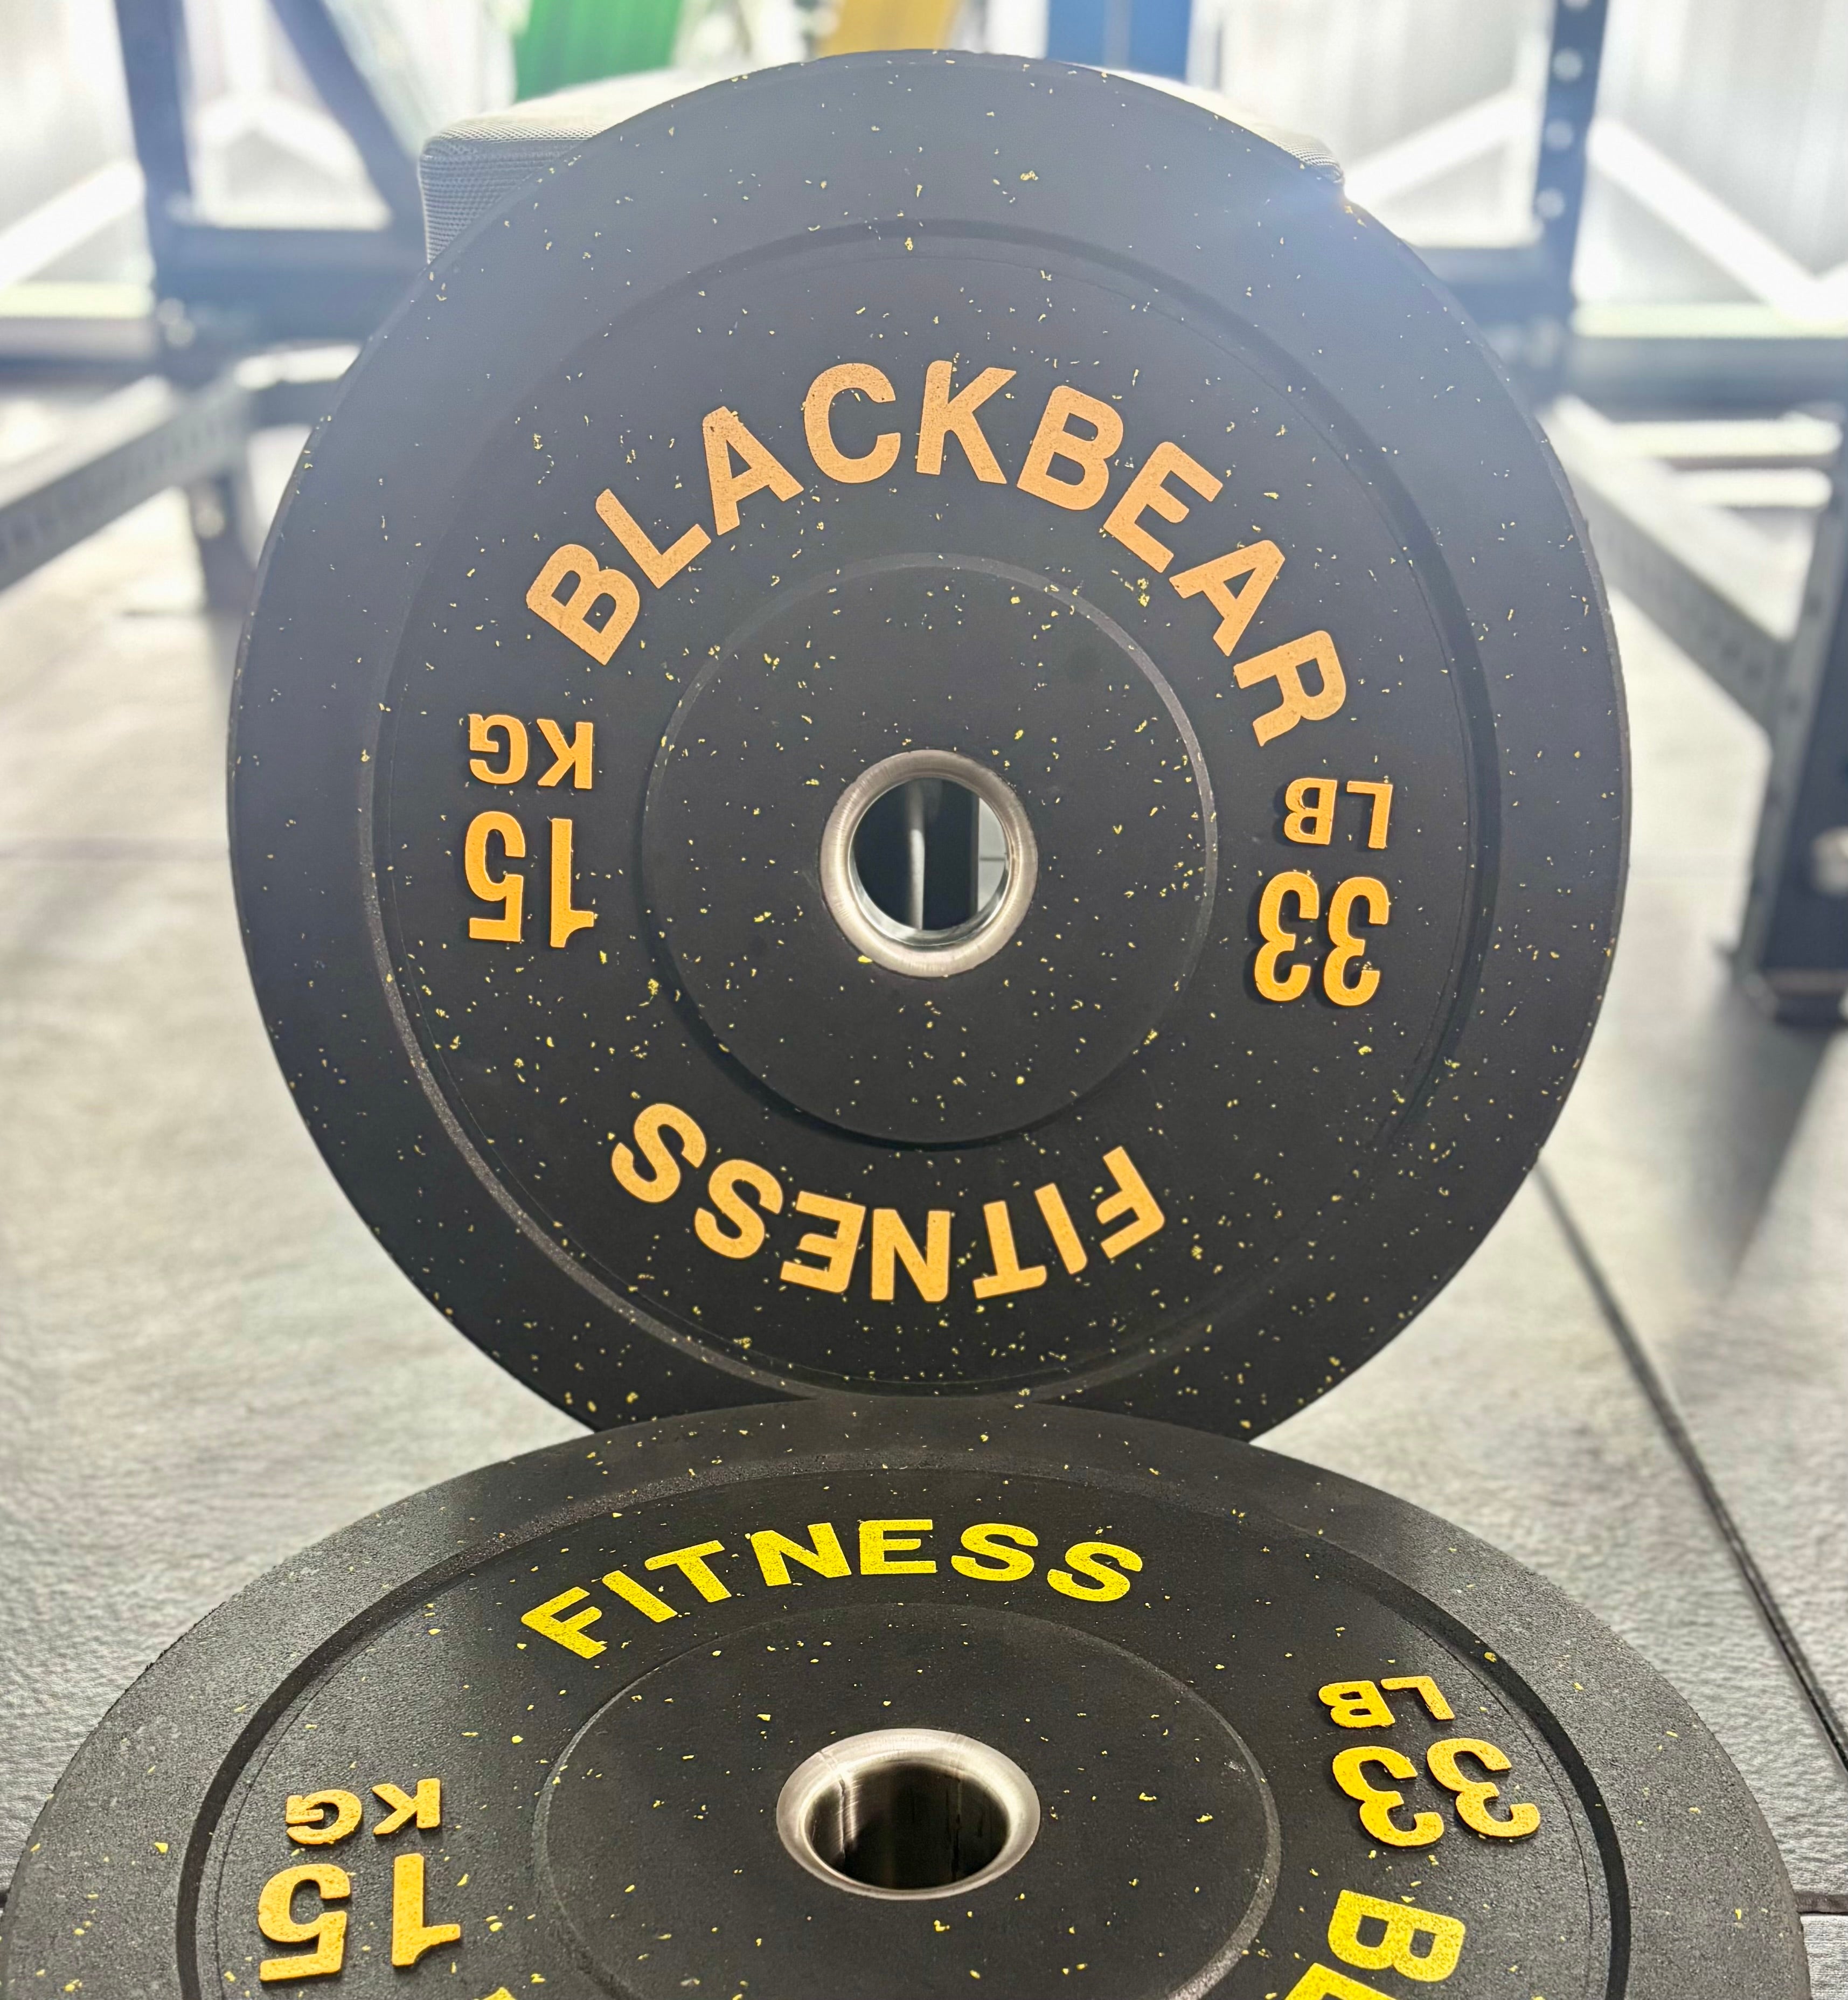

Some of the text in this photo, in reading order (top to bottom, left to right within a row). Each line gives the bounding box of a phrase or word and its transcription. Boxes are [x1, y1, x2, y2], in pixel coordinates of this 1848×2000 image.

[525, 360, 1347, 746] BLACKBEAR
[468, 713, 594, 789] KG
[1284, 777, 1393, 849] LB
[464, 810, 595, 948] 15
[1254, 871, 1390, 1006] 33
[611, 1103, 1165, 1303] FITNESS
[521, 1519, 1143, 1658] FITNESS
[1318, 1675, 1455, 1728] LB
[284, 1777, 442, 1845] KG
[1332, 1737, 1541, 1847] 33
[258, 1852, 462, 1982] 15
